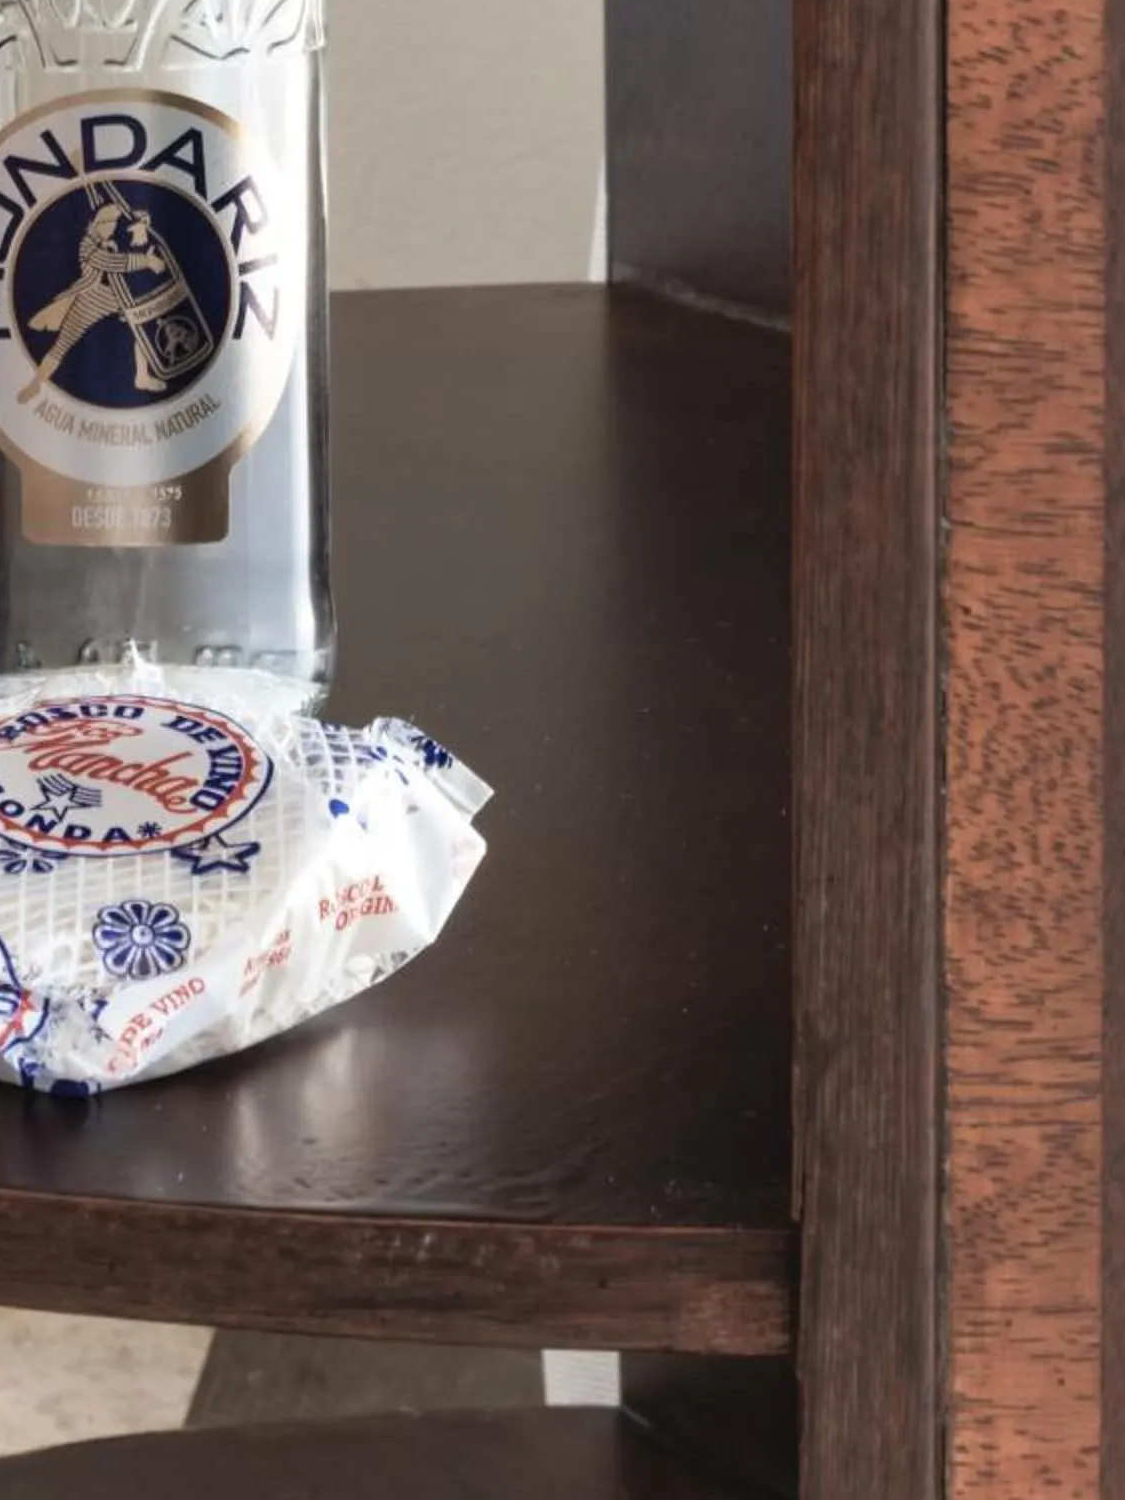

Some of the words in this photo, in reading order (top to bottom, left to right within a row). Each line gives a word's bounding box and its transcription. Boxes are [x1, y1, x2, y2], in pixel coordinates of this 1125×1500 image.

[33, 401, 75, 436] AGUA
[76, 419, 154, 447] MINERAL
[154, 394, 222, 442] NATURAL
[161, 714, 227, 744] DE
[188, 743, 244, 813] VINO
[148, 977, 207, 1017] VINO
